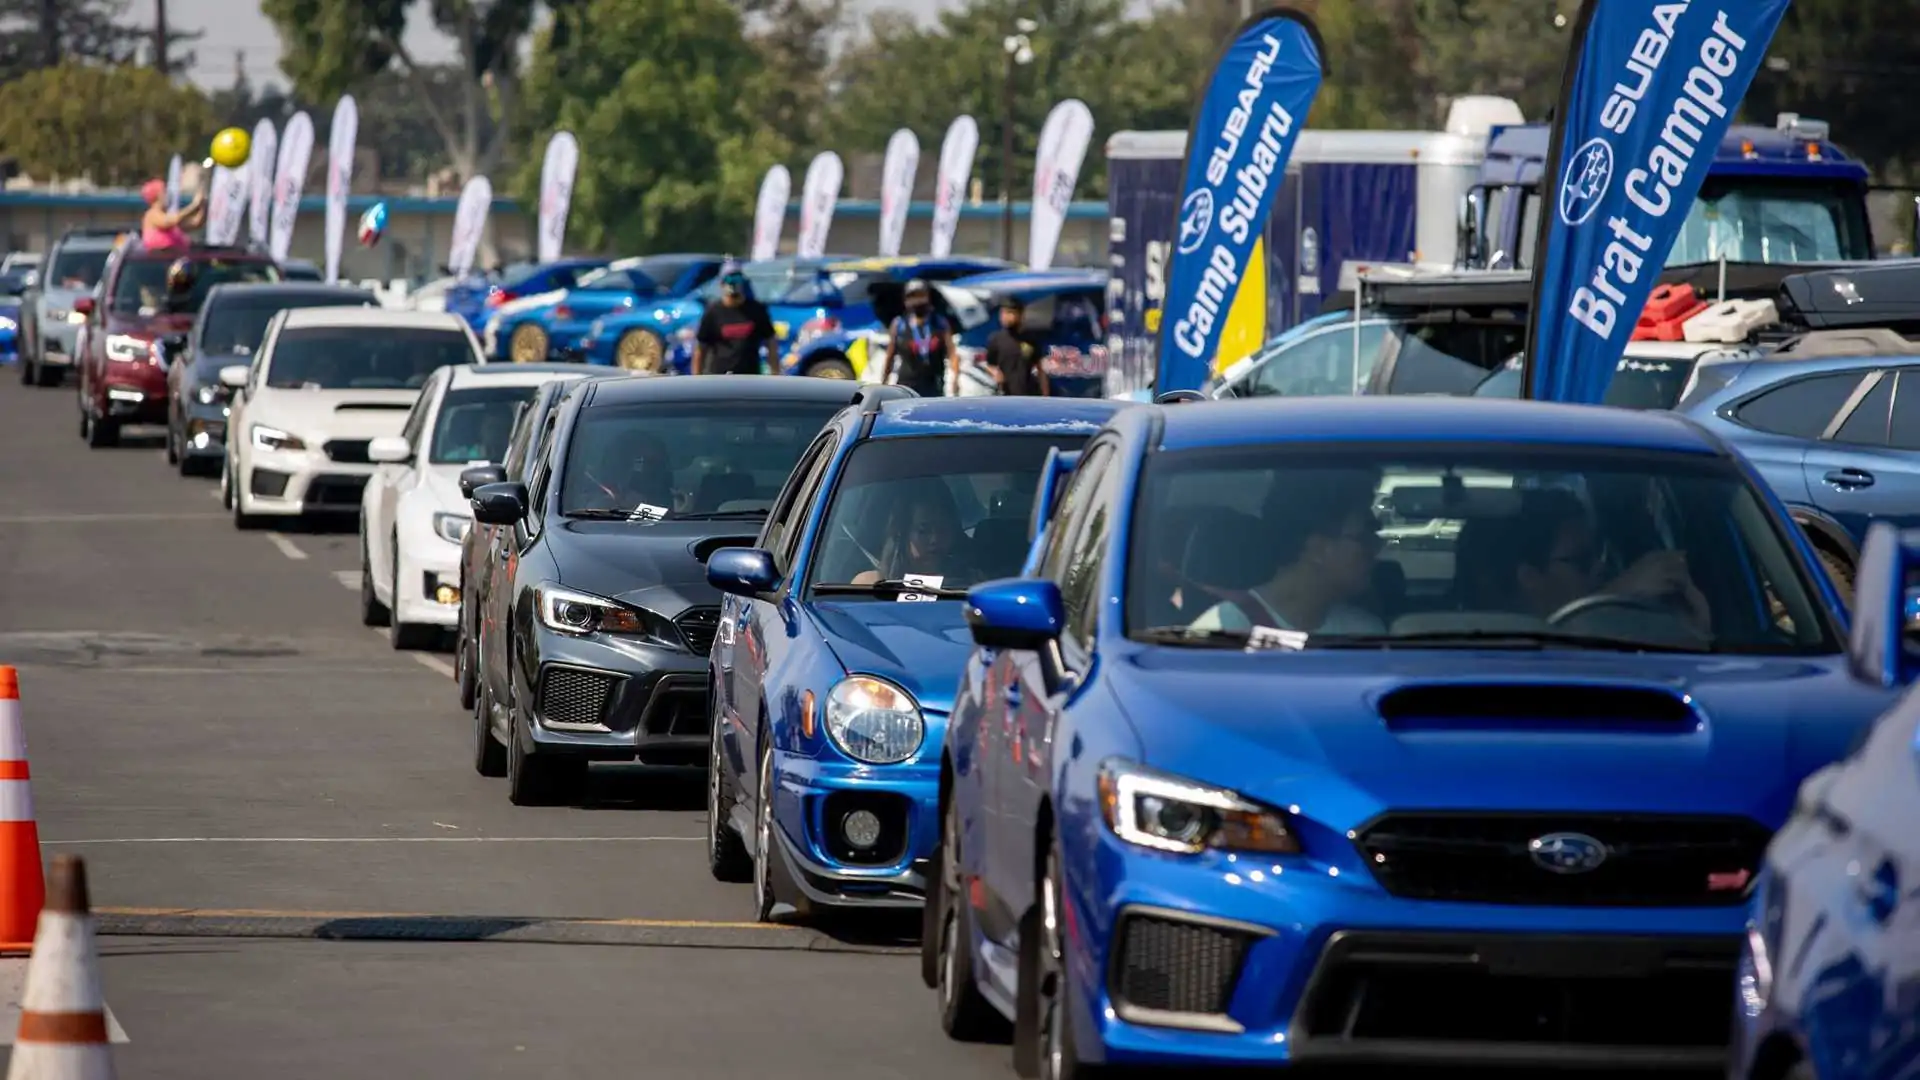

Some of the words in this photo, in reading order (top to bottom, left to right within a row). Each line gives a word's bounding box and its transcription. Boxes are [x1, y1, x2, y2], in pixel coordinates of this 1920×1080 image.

[1207, 34, 1280, 186] SUBARU
[1600, 0, 1691, 133] SUBA
[1174, 244, 1236, 358] Camp
[1220, 102, 1292, 245] Subaru
[1569, 216, 1652, 340] Brat
[1625, 10, 1747, 217] Camper
